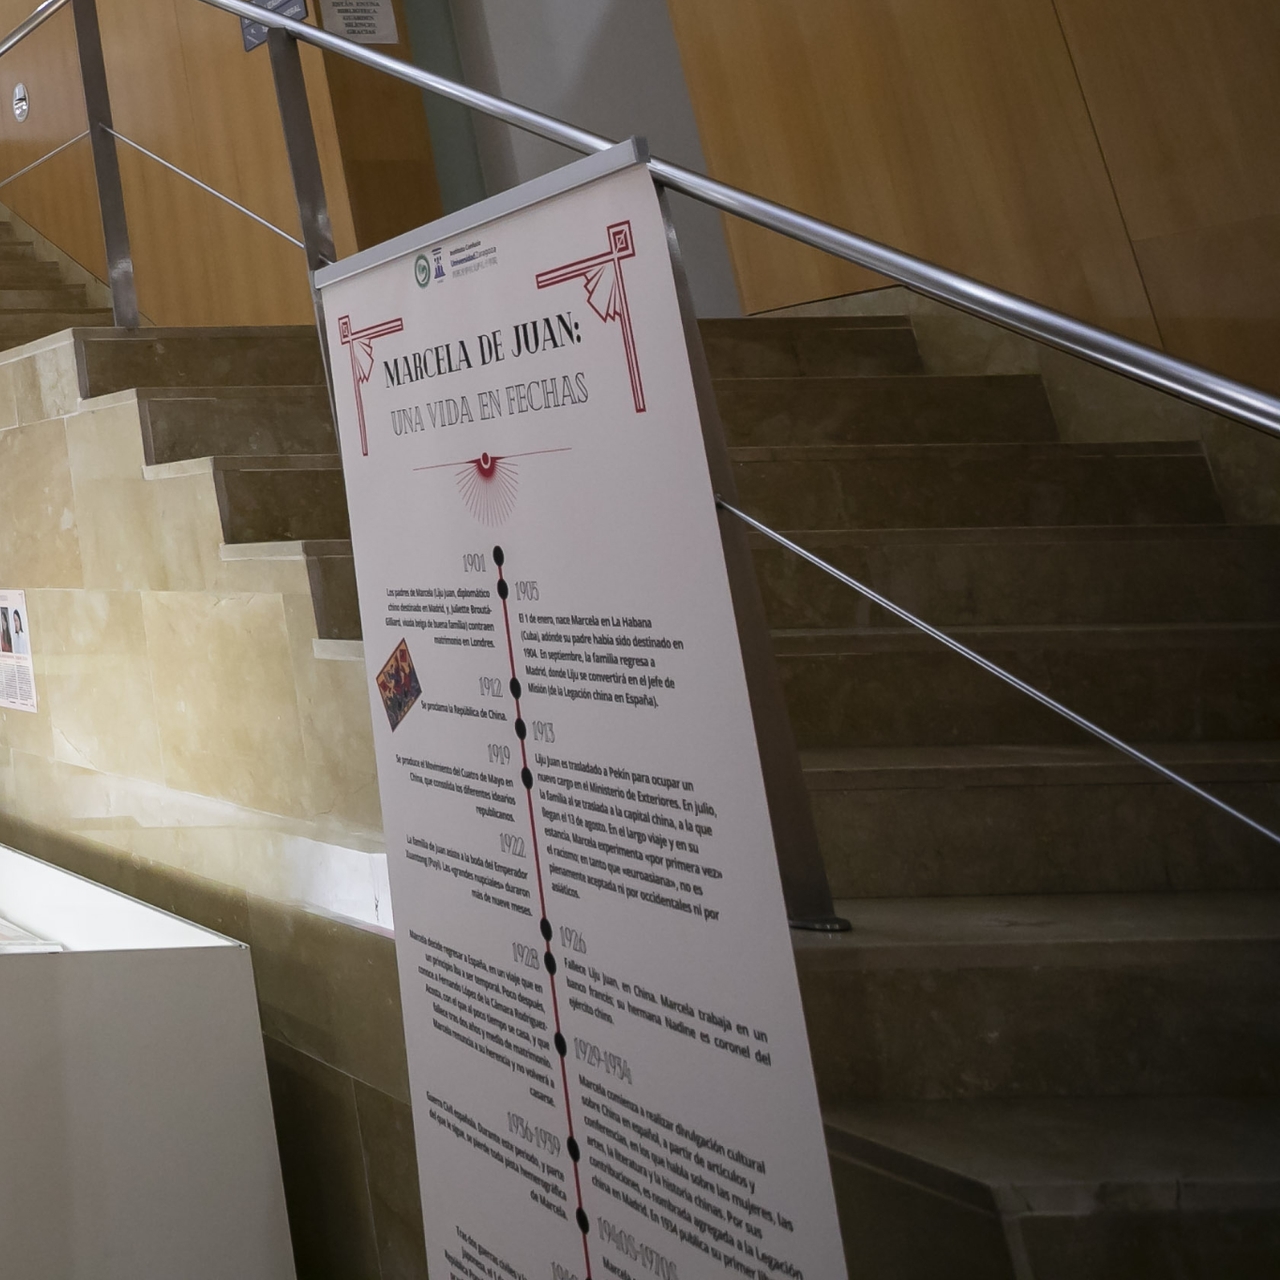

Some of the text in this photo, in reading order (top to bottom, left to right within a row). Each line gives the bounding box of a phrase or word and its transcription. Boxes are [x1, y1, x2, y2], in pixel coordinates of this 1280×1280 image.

[383, 340, 473, 387] MARCELA
[512, 311, 581, 358] JUAN:
[390, 405, 425, 436] UNA
[426, 396, 475, 428] VIDA
[505, 372, 589, 415] FECHAS
[462, 553, 487, 573] 1901
[514, 581, 540, 601] 1905
[555, 616, 571, 625] nace
[571, 615, 600, 626] Marcela
[622, 616, 652, 628] Habana
[470, 637, 495, 648] Londres.
[571, 633, 592, 646] padre
[615, 635, 632, 647] sido
[632, 636, 672, 649] destinado
[547, 651, 584, 663] septiembre,
[592, 652, 619, 665] familia
[619, 657, 649, 669] regresa
[525, 665, 548, 678] Madrid,
[548, 667, 567, 679] donde
[566, 669, 579, 682] Liju
[588, 672, 627, 684] convertirá
[479, 676, 504, 698] 1912
[563, 686, 592, 700] Legación
[592, 689, 613, 702] china
[625, 692, 659, 709] España).
[453, 705, 480, 718] República
[488, 709, 508, 721] China.
[532, 720, 555, 744] 1913
[487, 743, 511, 765] 1919
[534, 753, 547, 767] Liju
[568, 761, 603, 776] trasladado
[608, 766, 631, 781] Pekín
[631, 772, 651, 785] para
[651, 776, 680, 791] ocupar
[537, 773, 557, 785] nuevo
[557, 777, 574, 791] cargo
[589, 782, 625, 799] Ministerio
[637, 790, 682, 810] Exteriores.
[694, 801, 717, 818] julio,
[499, 832, 527, 859] 1922
[572, 832, 598, 849] Marcela
[597, 841, 644, 861] experimenta
[665, 857, 701, 875] primera
[559, 926, 587, 955] 1926
[512, 942, 540, 971] 1928
[633, 985, 658, 1004] China.
[660, 994, 695, 1018] Marcela
[698, 1009, 733, 1032] trabaja
[566, 976, 587, 994] banco
[627, 1001, 662, 1026] hermana
[665, 1016, 696, 1039] Nadine
[714, 1037, 751, 1059] coronel
[755, 1049, 772, 1067] del
[578, 1074, 607, 1097] Marcela
[675, 1123, 726, 1156] divulgación
[727, 1149, 766, 1175] cultural
